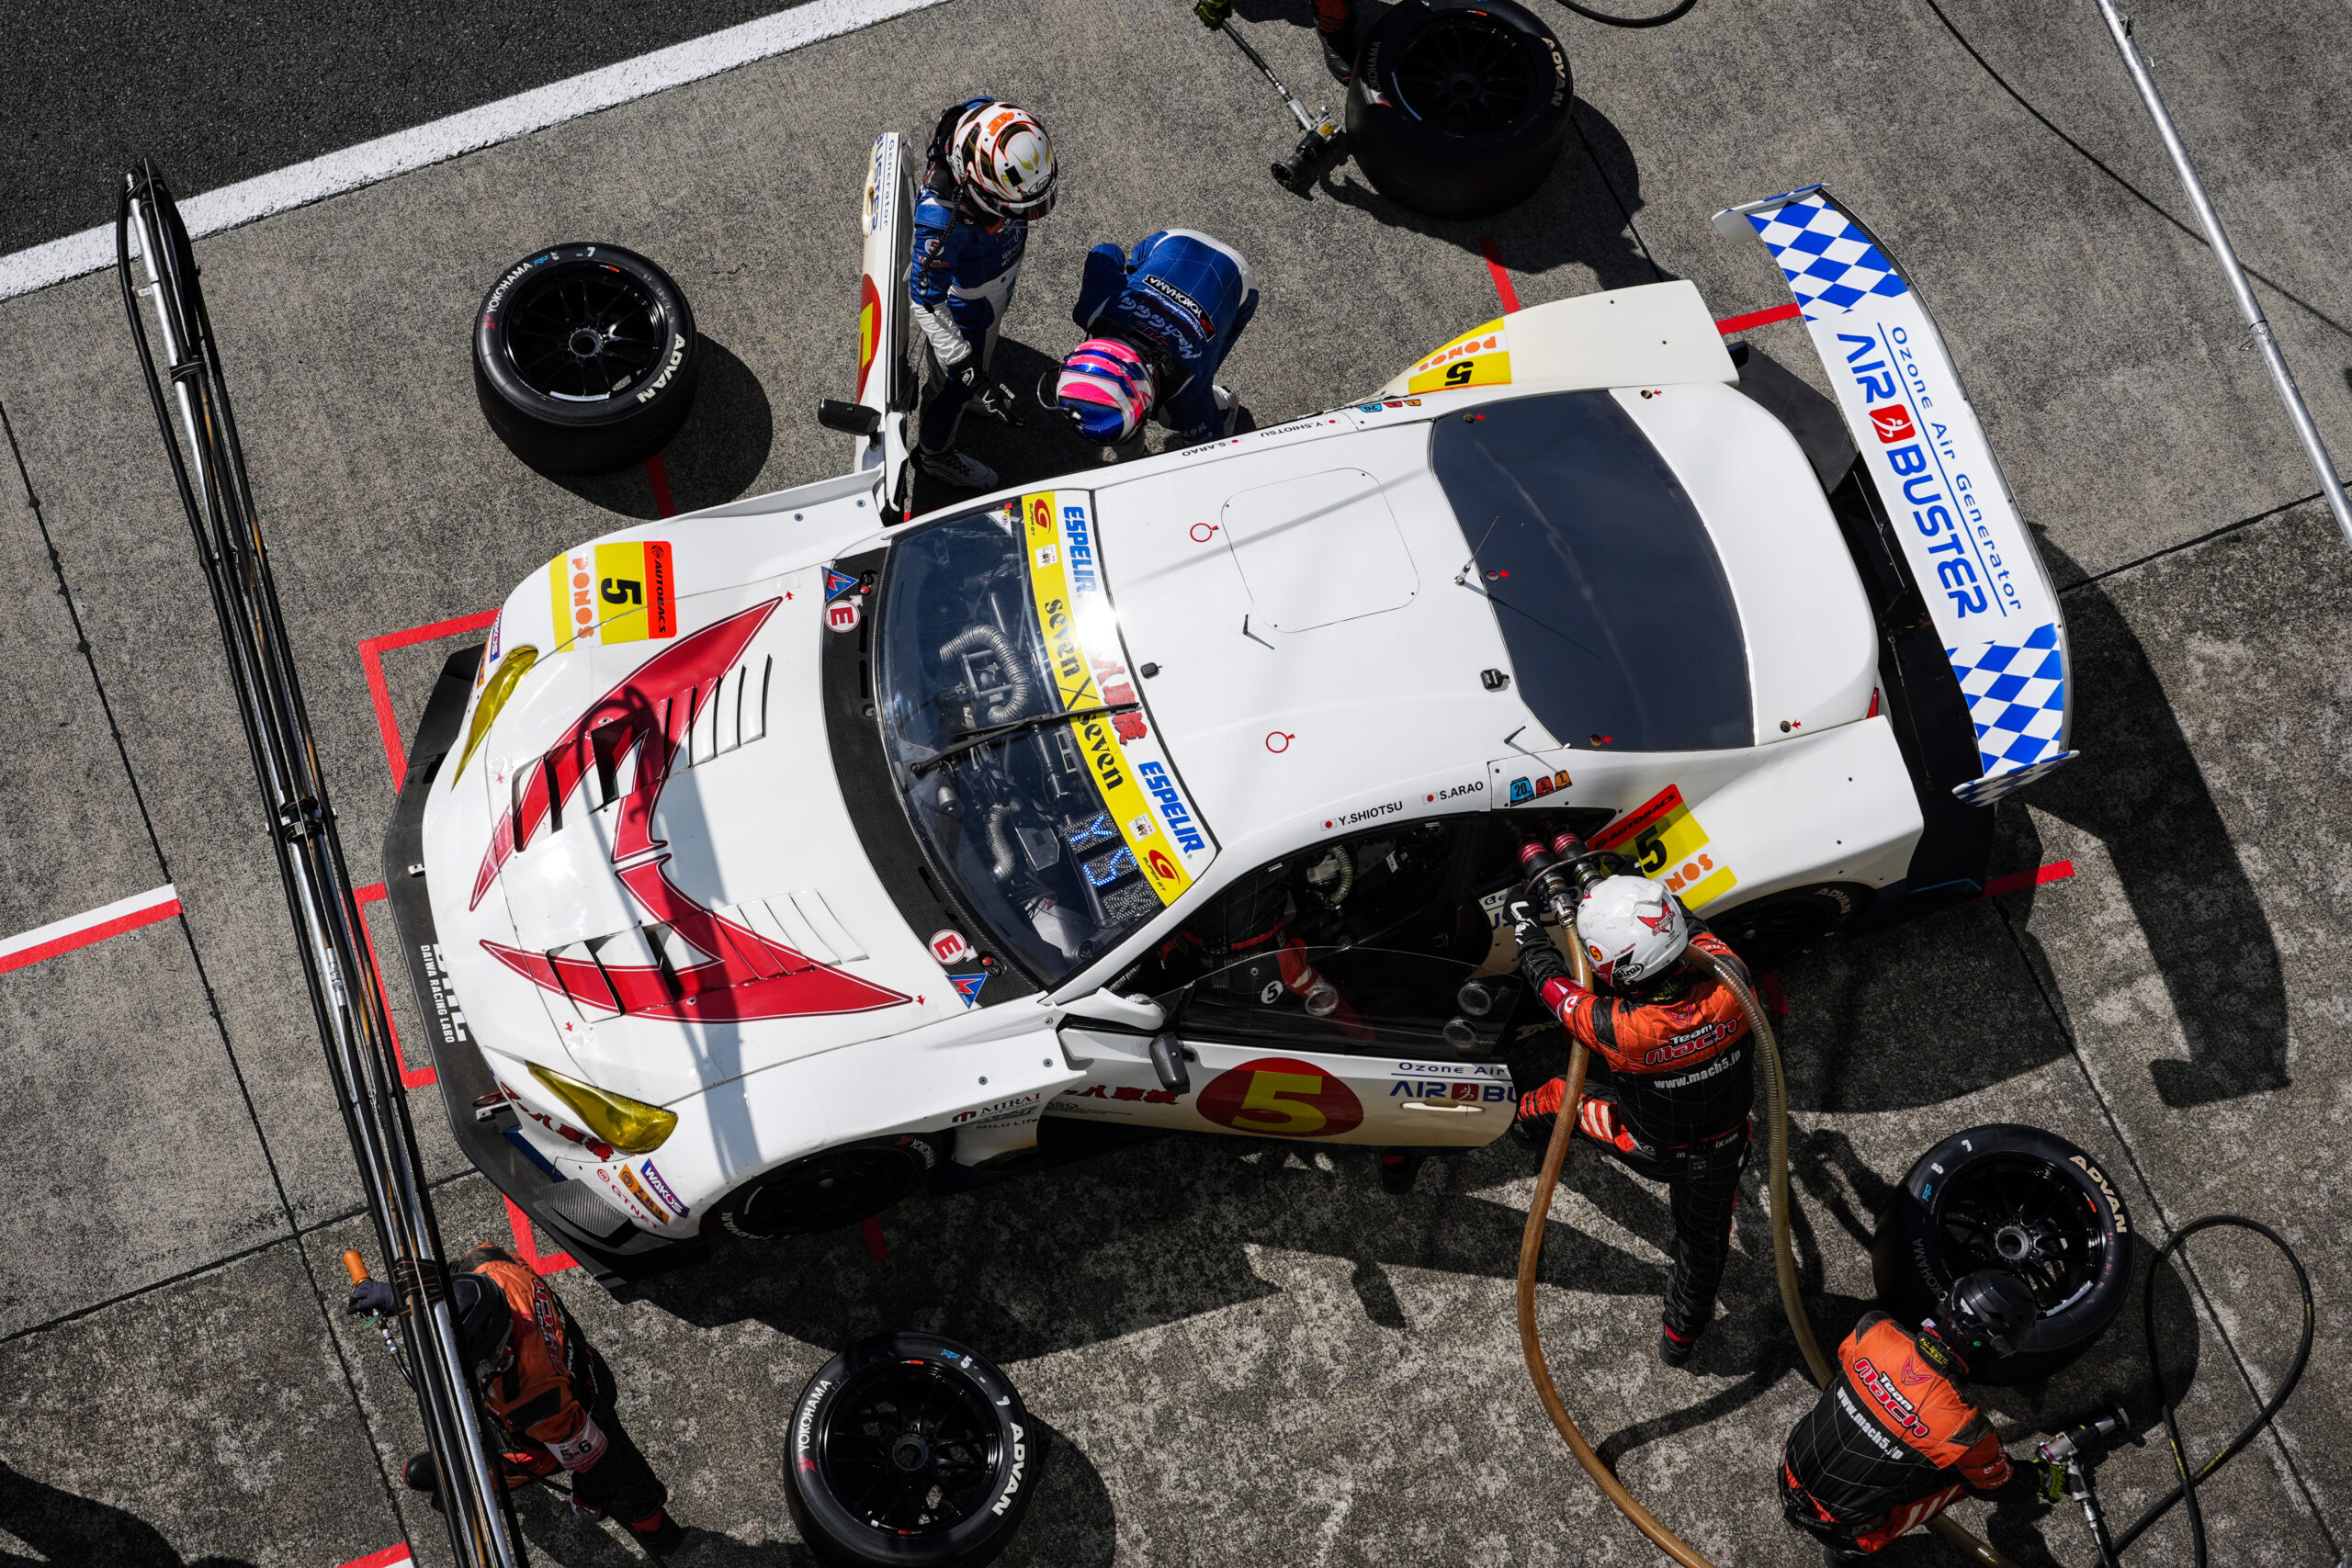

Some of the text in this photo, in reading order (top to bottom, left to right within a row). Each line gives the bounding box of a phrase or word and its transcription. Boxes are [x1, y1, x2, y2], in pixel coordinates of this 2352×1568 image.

[1541, 37, 1566, 107] ADVAN
[883, 140, 895, 227] Generator
[485, 262, 533, 313] YOKOHAMA
[1149, 277, 1203, 319] YOKOHAMA
[1161, 323, 1203, 359] Mach
[1419, 336, 1498, 372] PONOS
[636, 332, 685, 403] ADVAN
[1444, 360, 1474, 387] 5
[1182, 440, 1227, 457] S.ARAO
[1260, 421, 1324, 438] Y.SHIOTSU
[1837, 333, 1988, 619] AIR BUSTER
[1892, 326, 2021, 610] Ozone Air Generator
[1063, 506, 1097, 593] ESPELIR
[571, 556, 594, 638] PONOS
[600, 577, 642, 605] 5
[654, 560, 666, 634] AUTOBACS
[830, 606, 854, 626] E
[1137, 761, 1205, 855] ESPELIR
[1338, 800, 1404, 827] Y.SHIOTSU
[1439, 780, 1484, 801] S.ARAO
[1609, 791, 1677, 842] AUTOBACS
[1634, 823, 1668, 874] 5
[1662, 853, 1714, 894] NOS
[421, 944, 437, 977] DAIWA
[429, 979, 448, 1016] RACING
[440, 1017, 456, 1043] LABO
[1669, 1023, 1713, 1044] Team
[1388, 1080, 1447, 1099] AIR
[1398, 1062, 1505, 1077] Ozone Air
[1654, 1049, 1742, 1089] www.mach5.jp
[980, 1092, 1042, 1114] MIRAI
[1230, 1070, 1328, 1133] 5
[611, 1184, 662, 1230] GTNET
[2069, 1155, 2127, 1234] ADVAN
[1911, 1237, 1948, 1303] OKOHAMA
[798, 1380, 832, 1452] YOKOHAMA
[1879, 1371, 1915, 1411] Team
[1837, 1386, 1905, 1461] www.mach5.jp
[991, 1421, 1026, 1517] ADVAN
